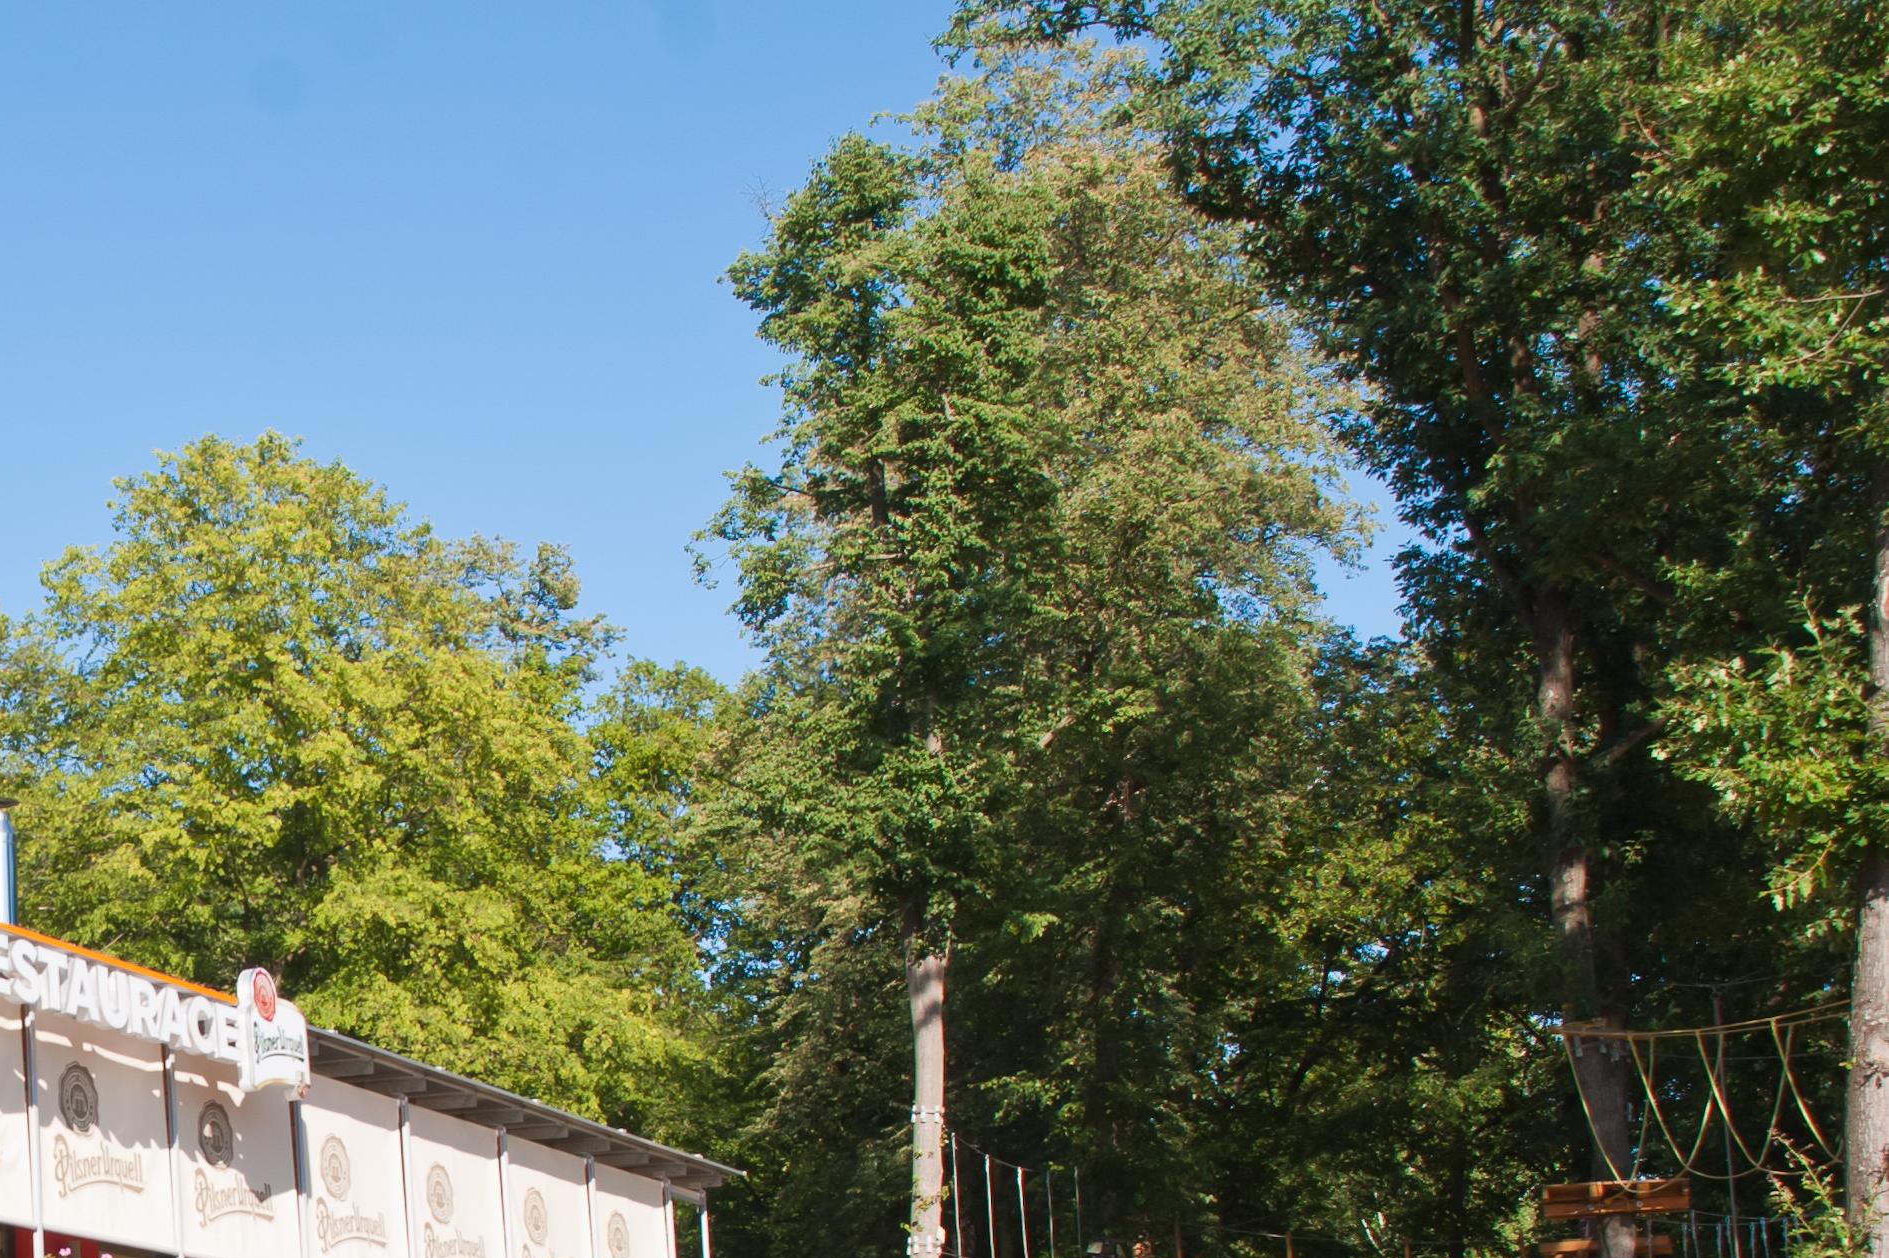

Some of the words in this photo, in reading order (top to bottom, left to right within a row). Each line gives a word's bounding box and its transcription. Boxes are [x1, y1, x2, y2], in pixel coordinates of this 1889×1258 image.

[54, 1134, 102, 1198] Pilsner
[101, 1140, 143, 1192] Urquell
[194, 1167, 237, 1229] Pilsner
[235, 1174, 274, 1219] Urquell
